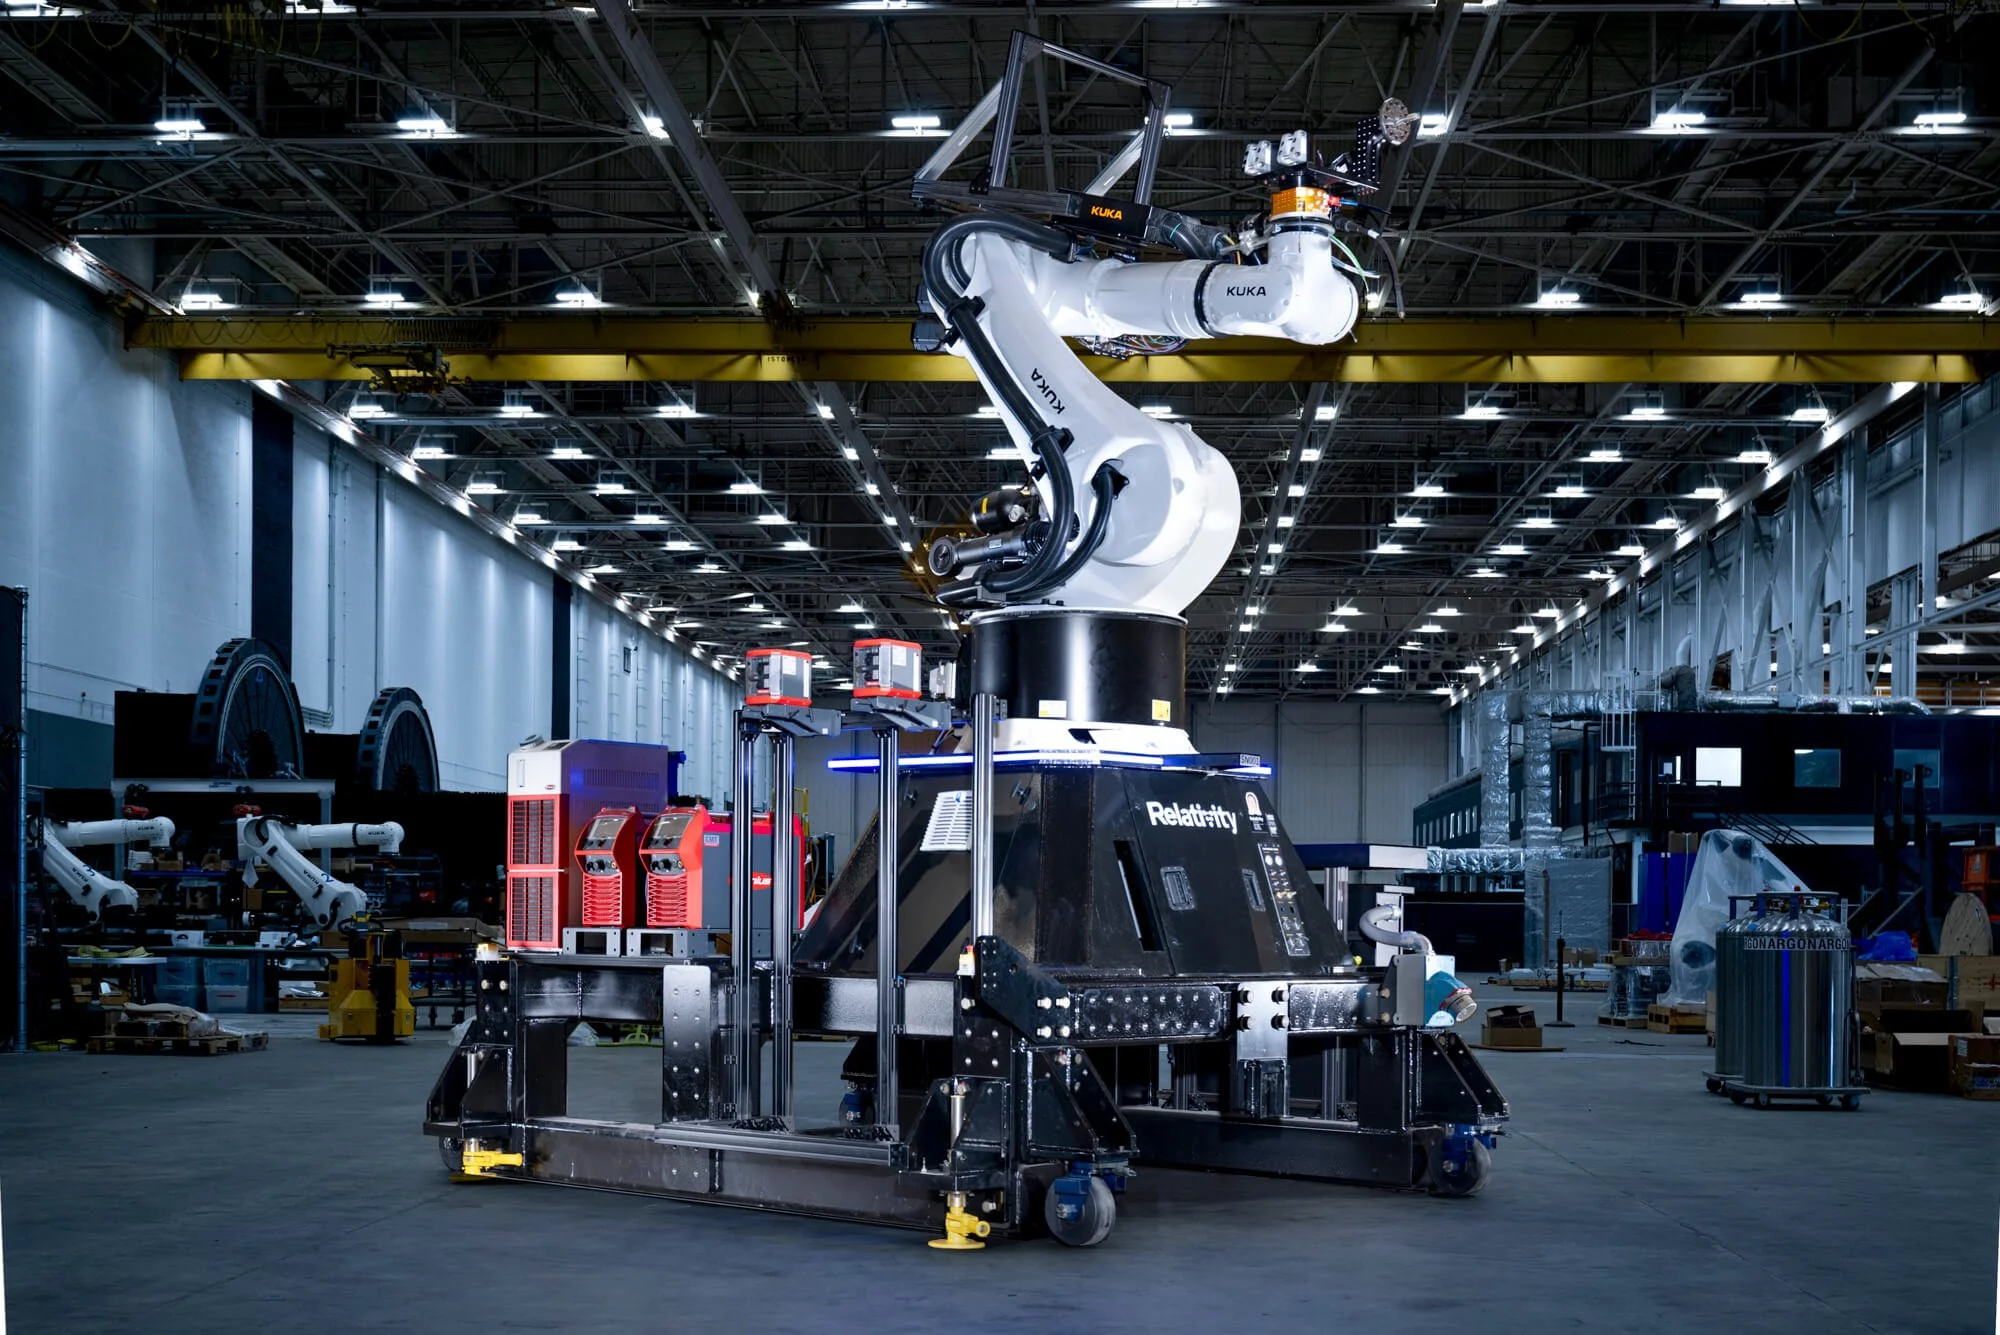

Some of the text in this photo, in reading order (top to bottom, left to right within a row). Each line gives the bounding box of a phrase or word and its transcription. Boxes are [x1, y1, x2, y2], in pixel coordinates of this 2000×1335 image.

[1090, 205, 1123, 221] KUKA
[1226, 286, 1266, 297] KUKA
[1032, 368, 1065, 414] KUKA
[1146, 801, 1238, 835] Relativity
[752, 876, 773, 885] nius
[1767, 938, 1816, 949] ARGON
